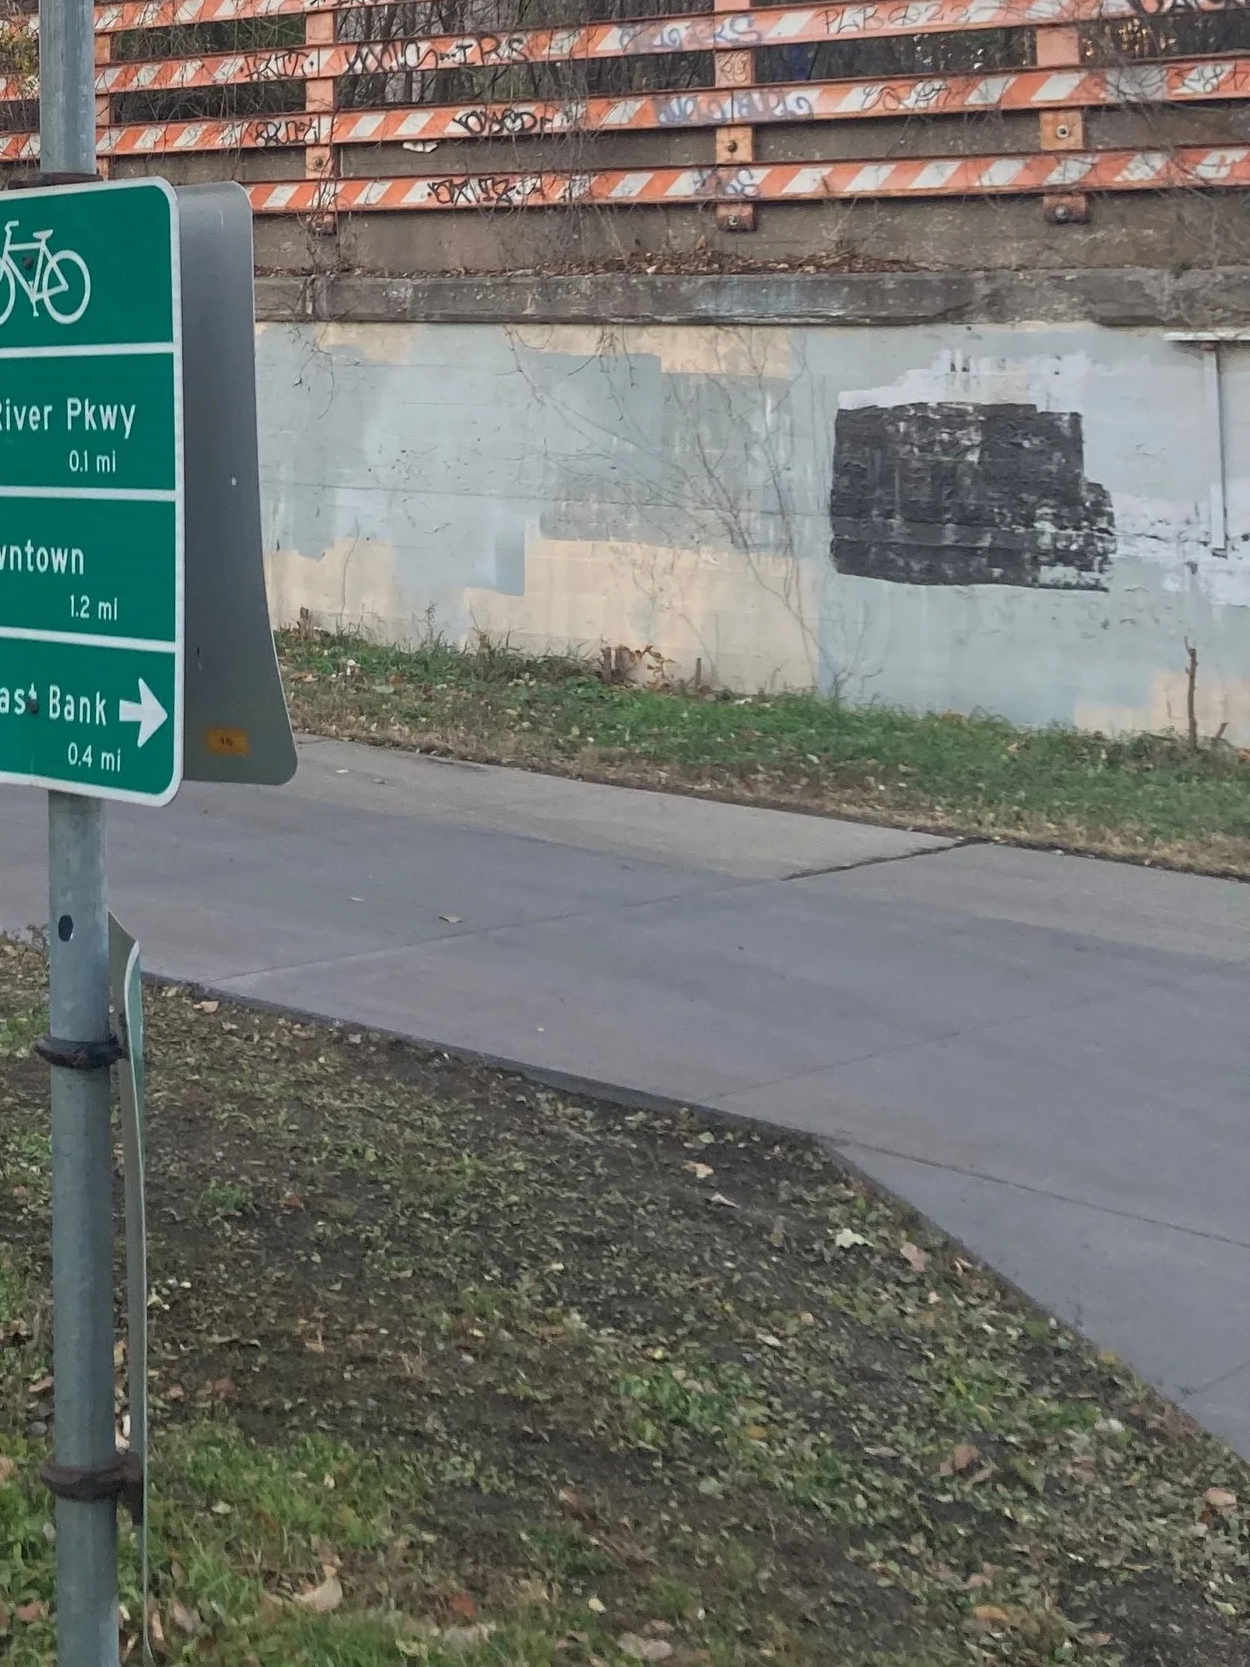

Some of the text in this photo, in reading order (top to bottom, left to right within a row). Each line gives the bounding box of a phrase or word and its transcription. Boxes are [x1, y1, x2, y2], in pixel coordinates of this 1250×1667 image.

[66, 396, 137, 440] Pkwy
[68, 449, 117, 473] 0.1 mi
[69, 593, 91, 619] 1.2
[48, 684, 108, 727] Bank
[67, 741, 122, 773] 0.4 mi
